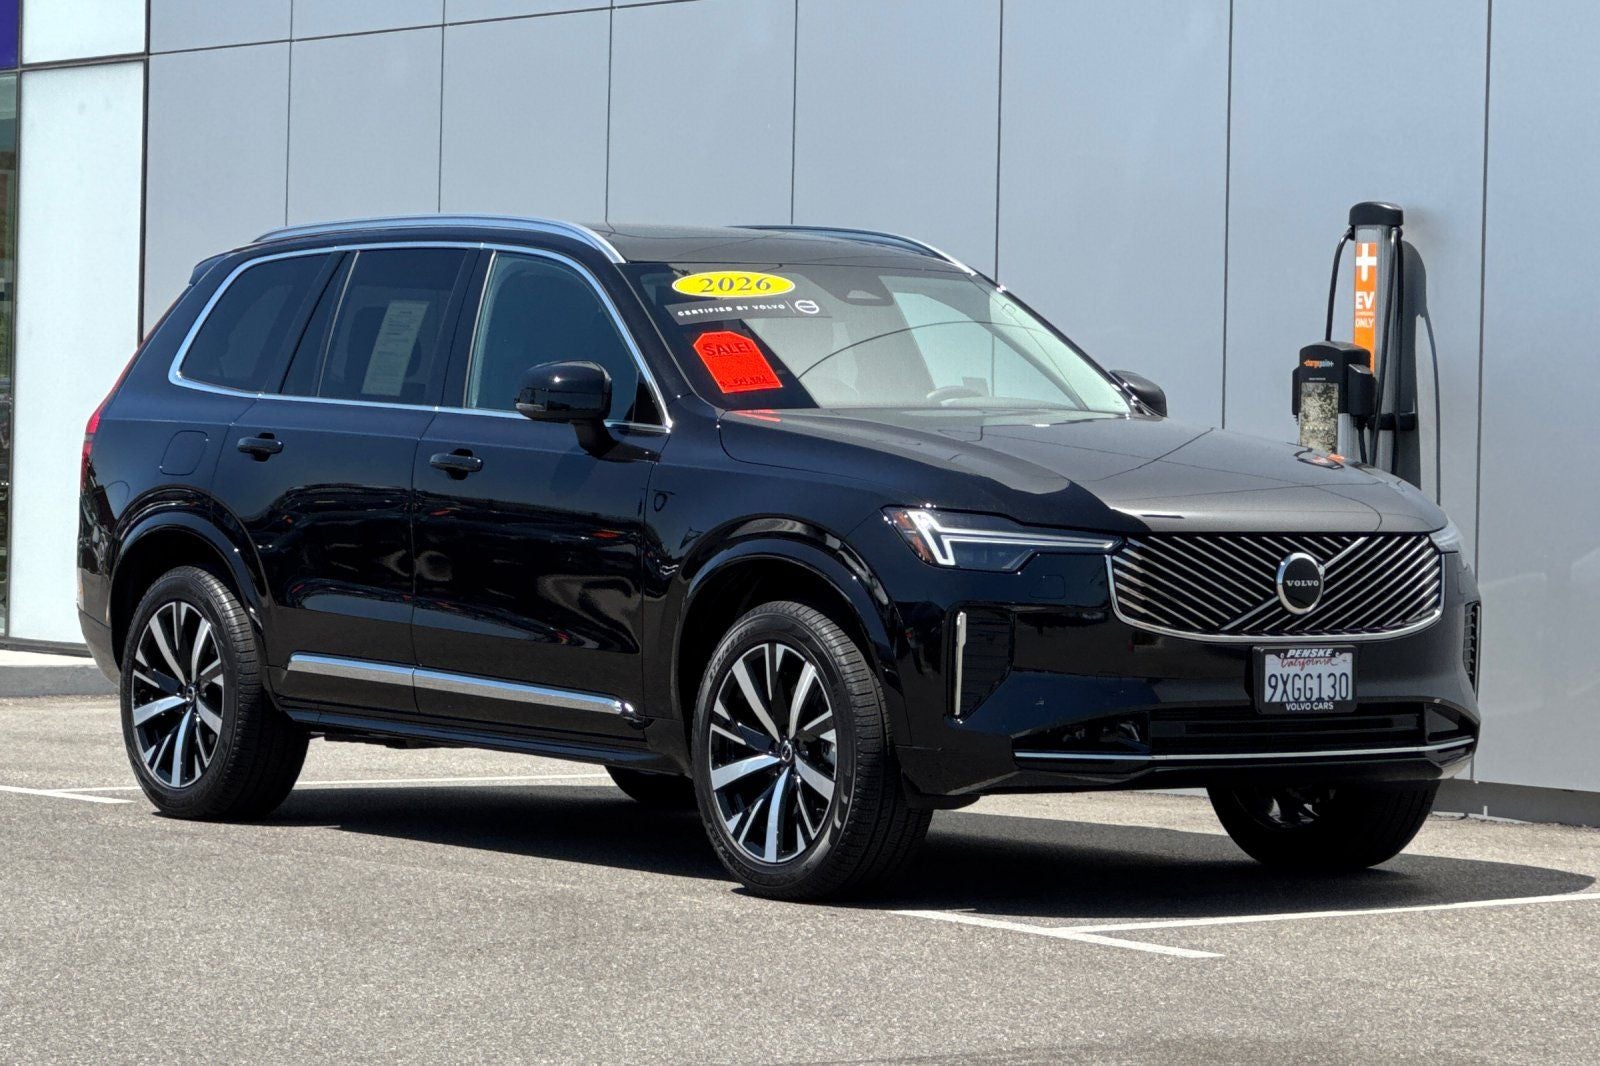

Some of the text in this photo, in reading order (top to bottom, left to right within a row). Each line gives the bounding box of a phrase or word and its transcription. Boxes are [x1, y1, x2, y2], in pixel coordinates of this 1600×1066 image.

[698, 276, 772, 293] 2026
[1355, 291, 1375, 309] EV
[677, 306, 733, 317] CERTIFIED
[1355, 318, 1374, 328] ONLY
[702, 342, 753, 357] SALE!
[1286, 648, 1334, 658] PENSKE
[1268, 672, 1349, 702] 9XGG130
[1286, 701, 1334, 711] VOLVO CARS
